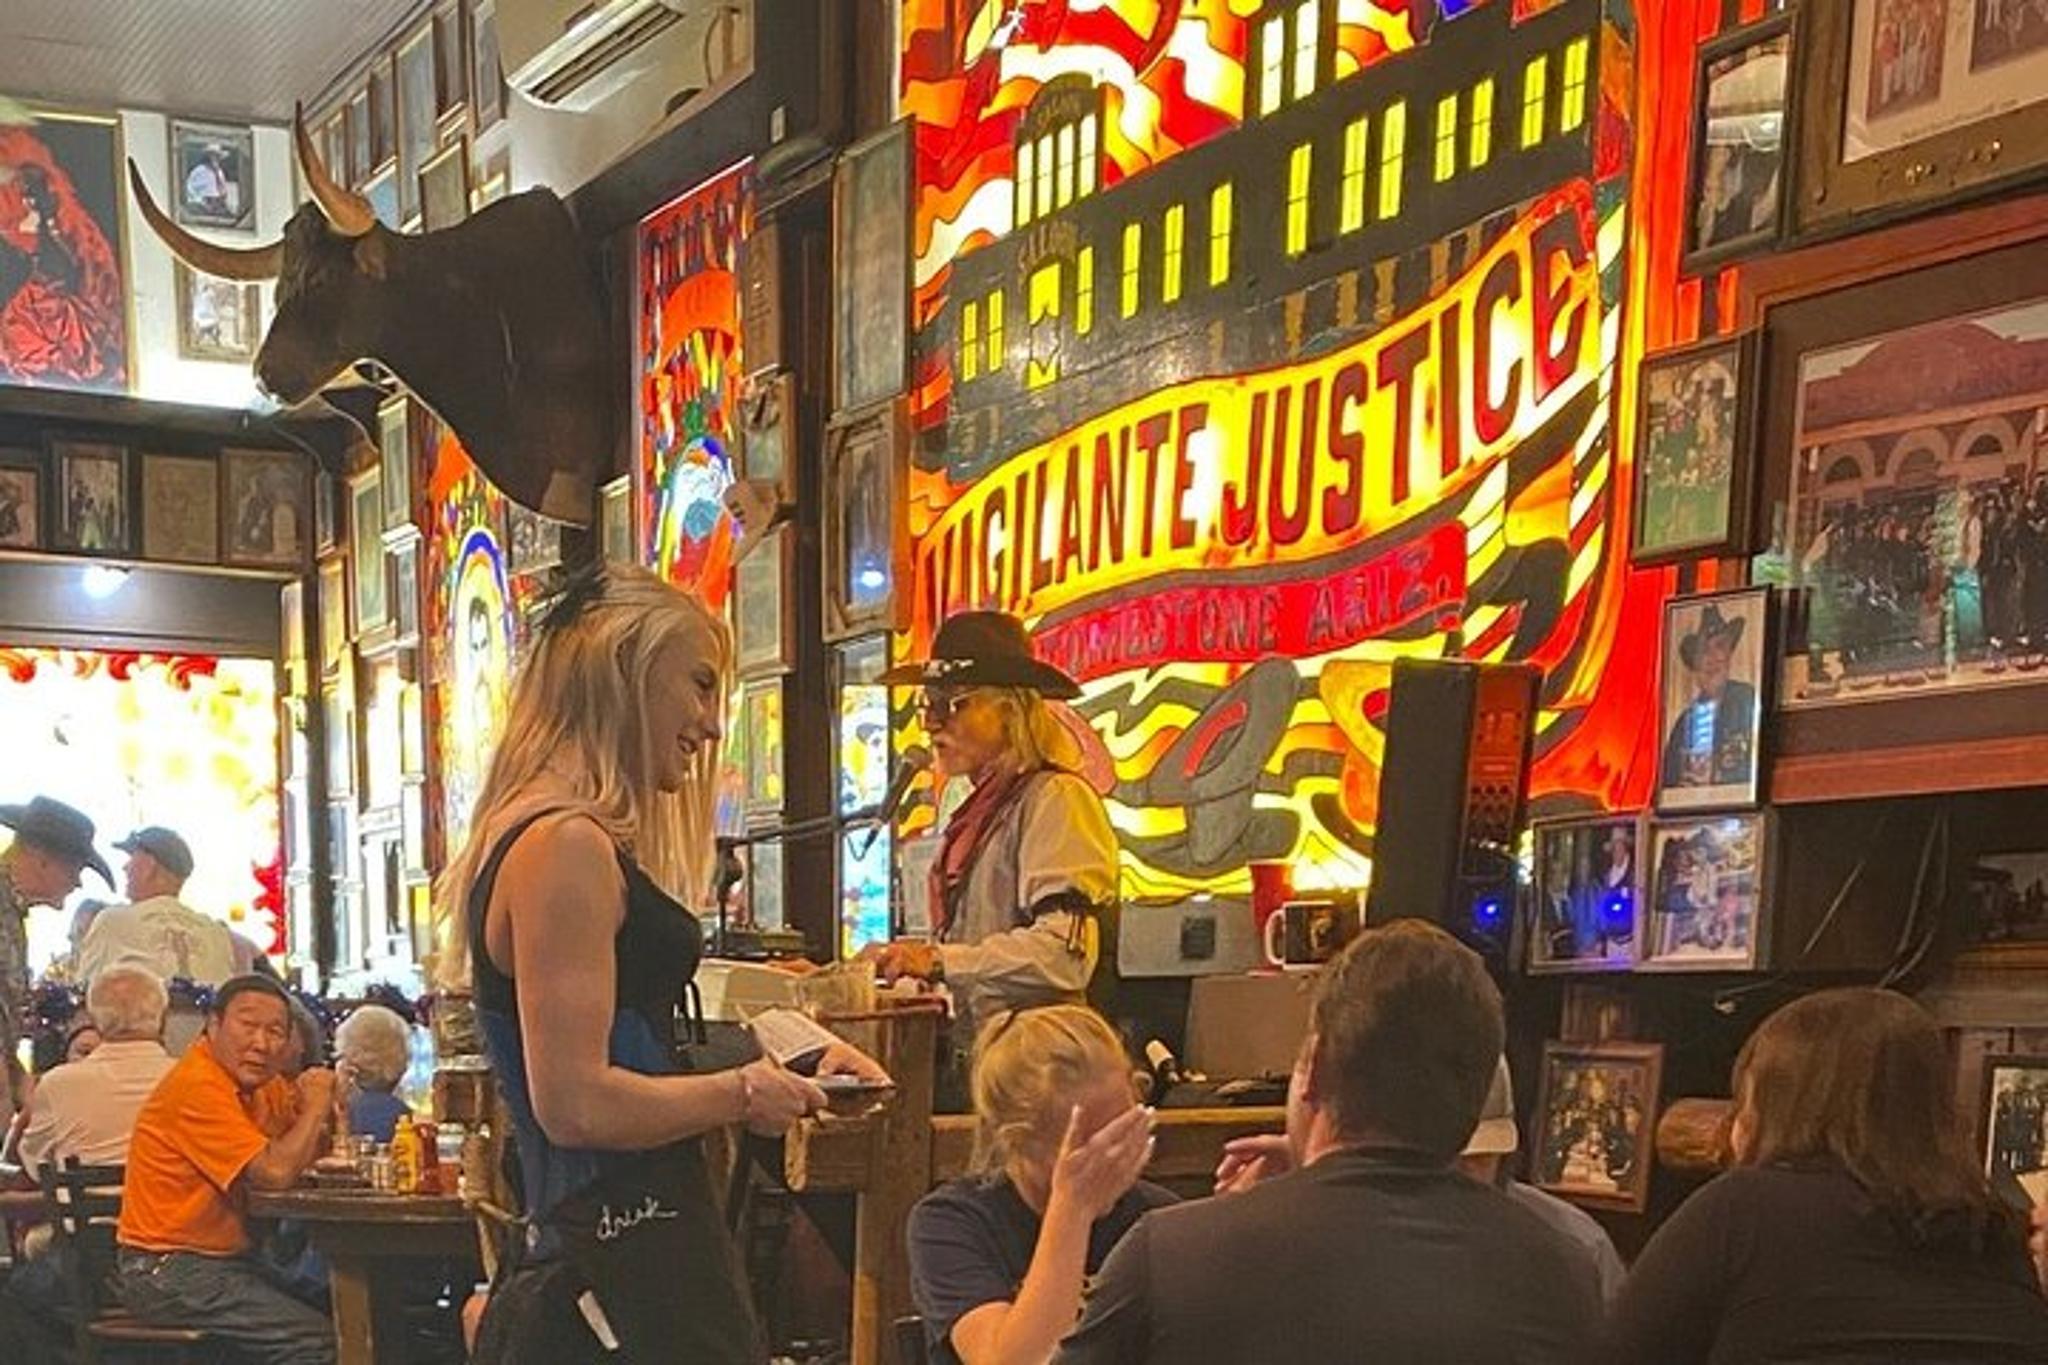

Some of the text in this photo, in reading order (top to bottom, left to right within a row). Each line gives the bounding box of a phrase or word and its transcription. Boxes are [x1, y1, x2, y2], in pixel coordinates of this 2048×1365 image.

[925, 212, 1589, 628] VIGILANTE JUSTICE
[1035, 586, 1278, 677] TOMBSTONE
